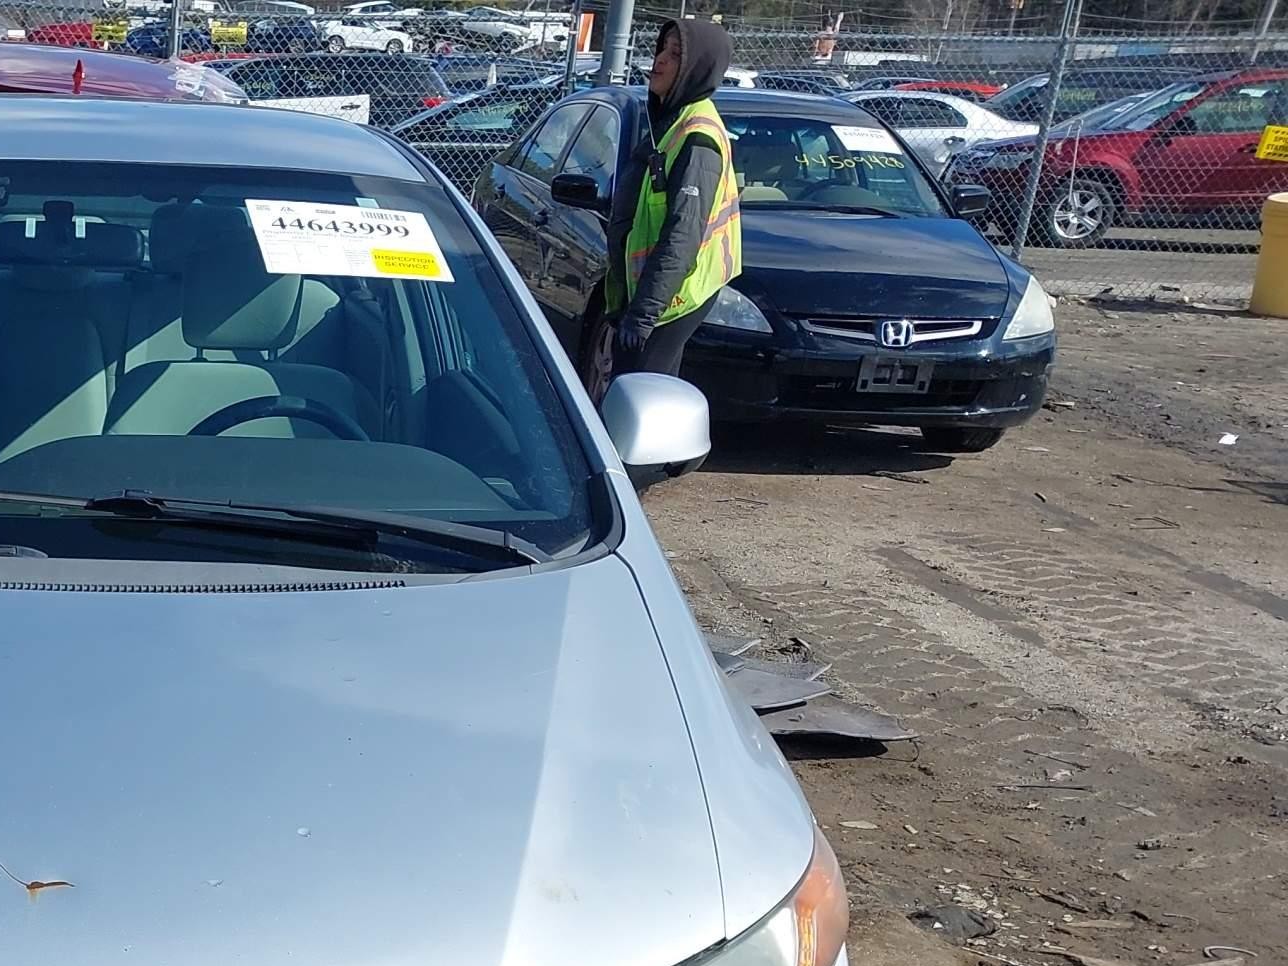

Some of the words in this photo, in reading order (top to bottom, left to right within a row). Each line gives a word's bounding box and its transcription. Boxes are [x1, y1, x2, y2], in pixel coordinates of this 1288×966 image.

[795, 154, 905, 170] 44509428
[271, 216, 410, 238] 44643999
[374, 254, 435, 264] INSPECTION
[384, 261, 430, 270] SERVICE
